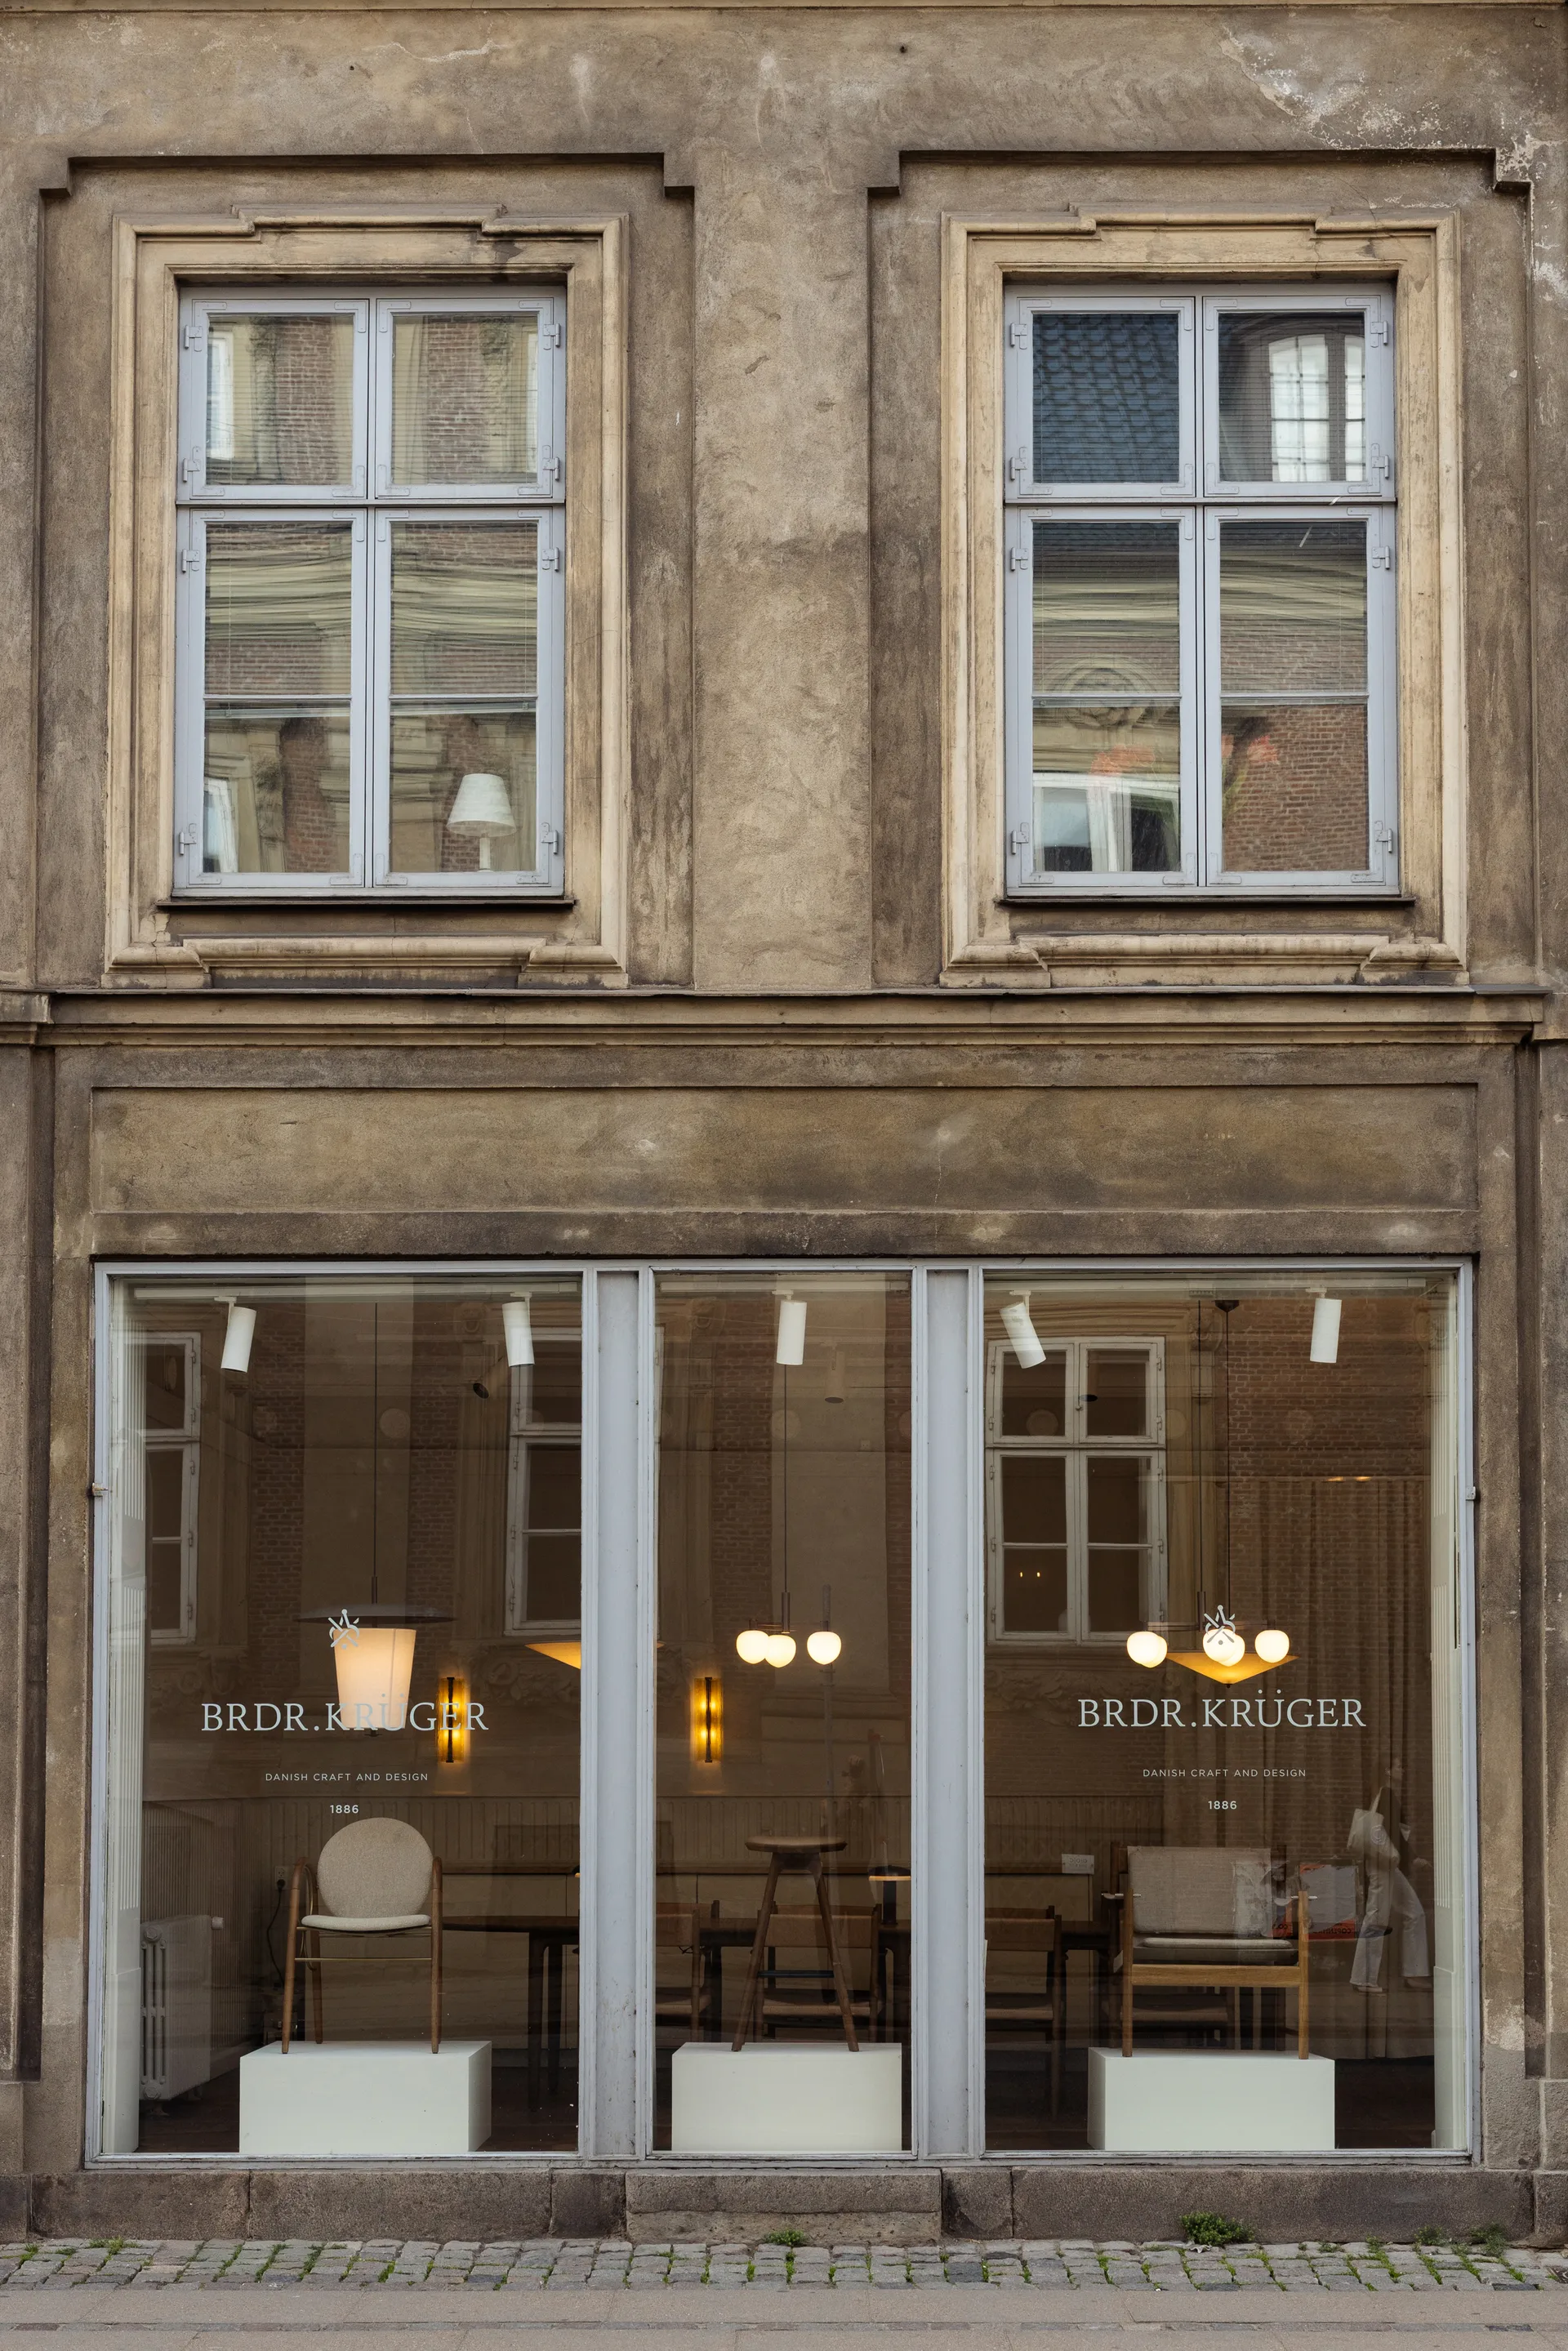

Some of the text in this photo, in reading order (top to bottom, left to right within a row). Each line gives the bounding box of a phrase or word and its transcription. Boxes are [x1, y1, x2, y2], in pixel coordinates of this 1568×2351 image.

[265, 1773, 429, 1781] DANISH CRAFT AND DESIGN
[1143, 1769, 1307, 1777] DANISH CRAFT AND DESIGN
[330, 1805, 359, 1814] 1886
[1208, 1801, 1237, 1810] 1886
